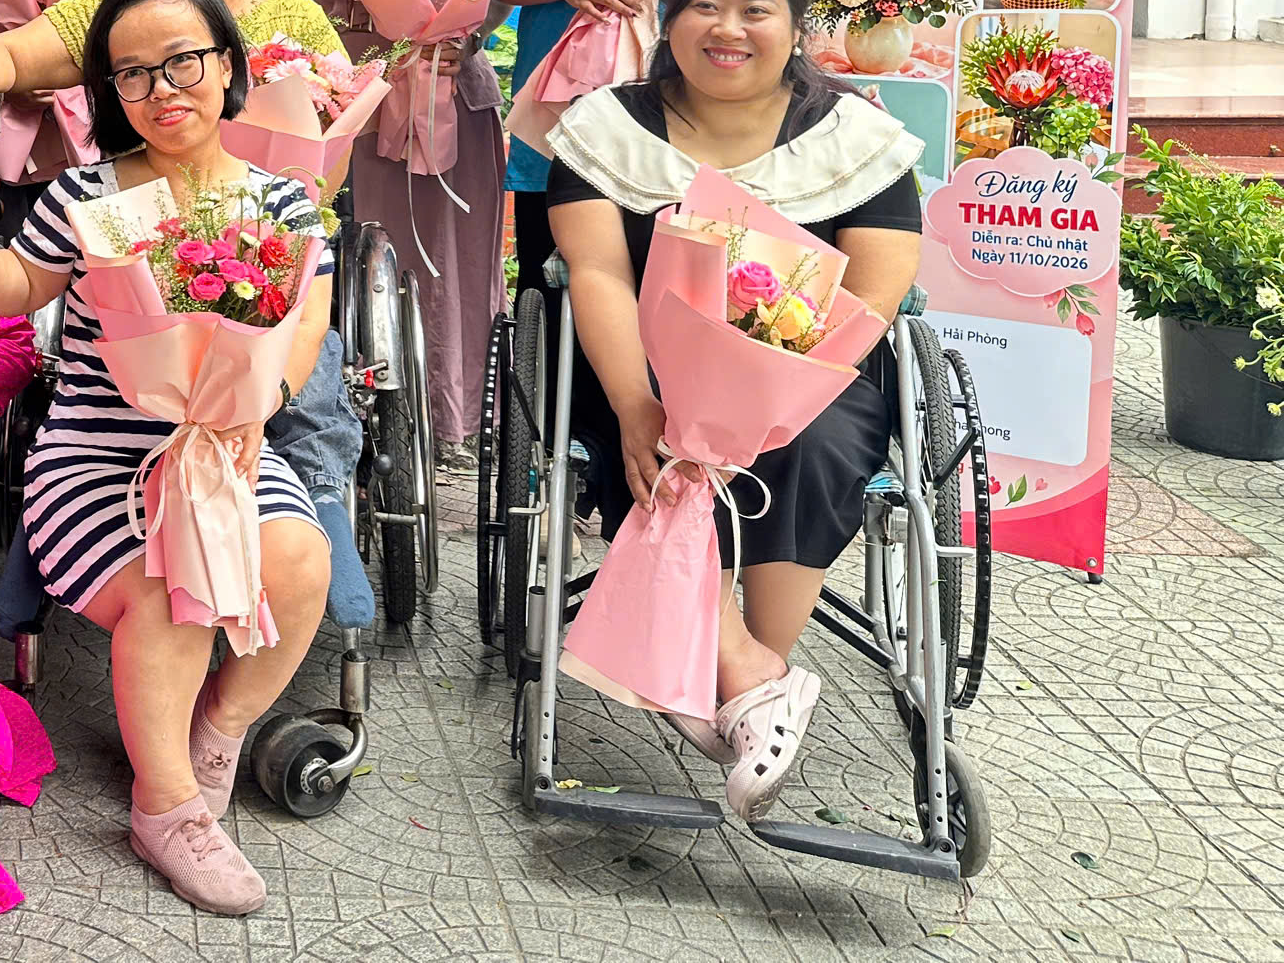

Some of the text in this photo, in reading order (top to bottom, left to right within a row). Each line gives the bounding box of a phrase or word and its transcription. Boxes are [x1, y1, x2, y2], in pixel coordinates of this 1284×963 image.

[974, 169, 1078, 204] Đăng ký
[958, 203, 1100, 232] THAM GIA
[972, 229, 1088, 253] Diễn ra: Chủ nhật
[972, 248, 1088, 269] Ngày 11/10/2026
[943, 327, 964, 341] Hải
[967, 331, 1008, 349] Phòng
